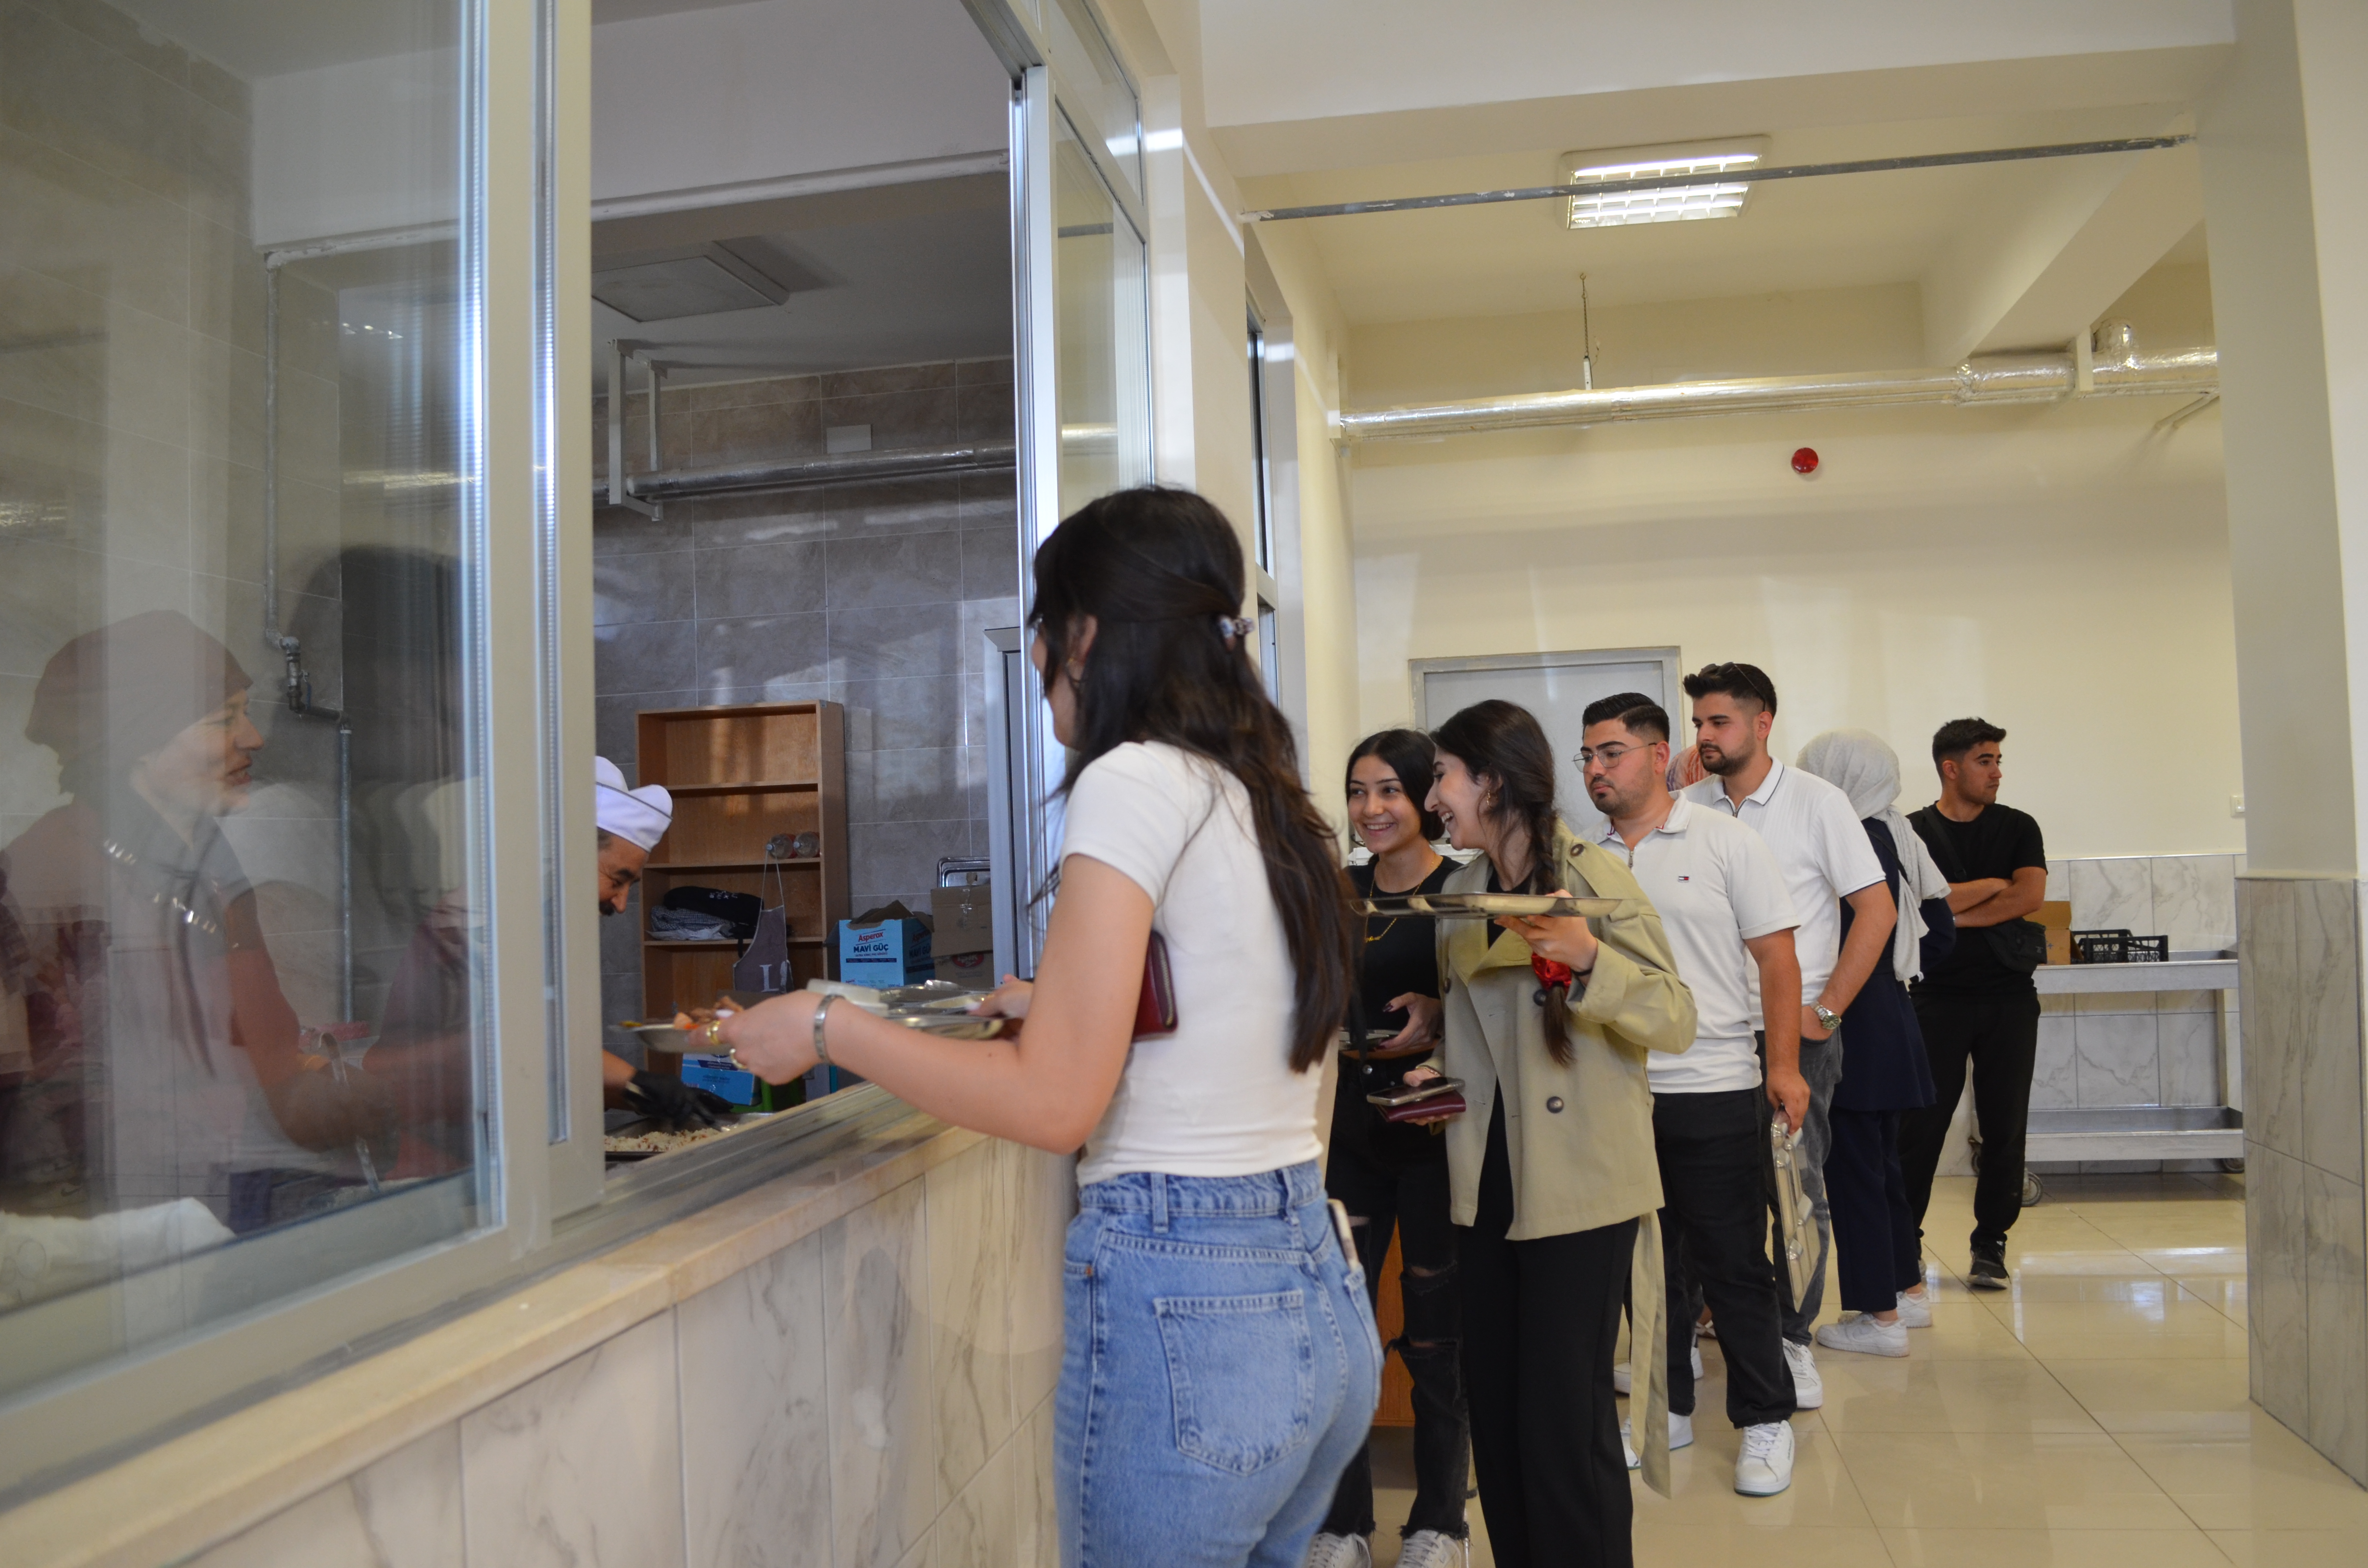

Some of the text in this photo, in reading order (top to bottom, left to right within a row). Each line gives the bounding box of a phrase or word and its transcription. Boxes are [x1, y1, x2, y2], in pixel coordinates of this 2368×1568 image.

[858, 932, 883, 942] Asperox
[853, 943, 889, 953] MAVİ GÜÇ
[922, 943, 931, 955] GÜ
